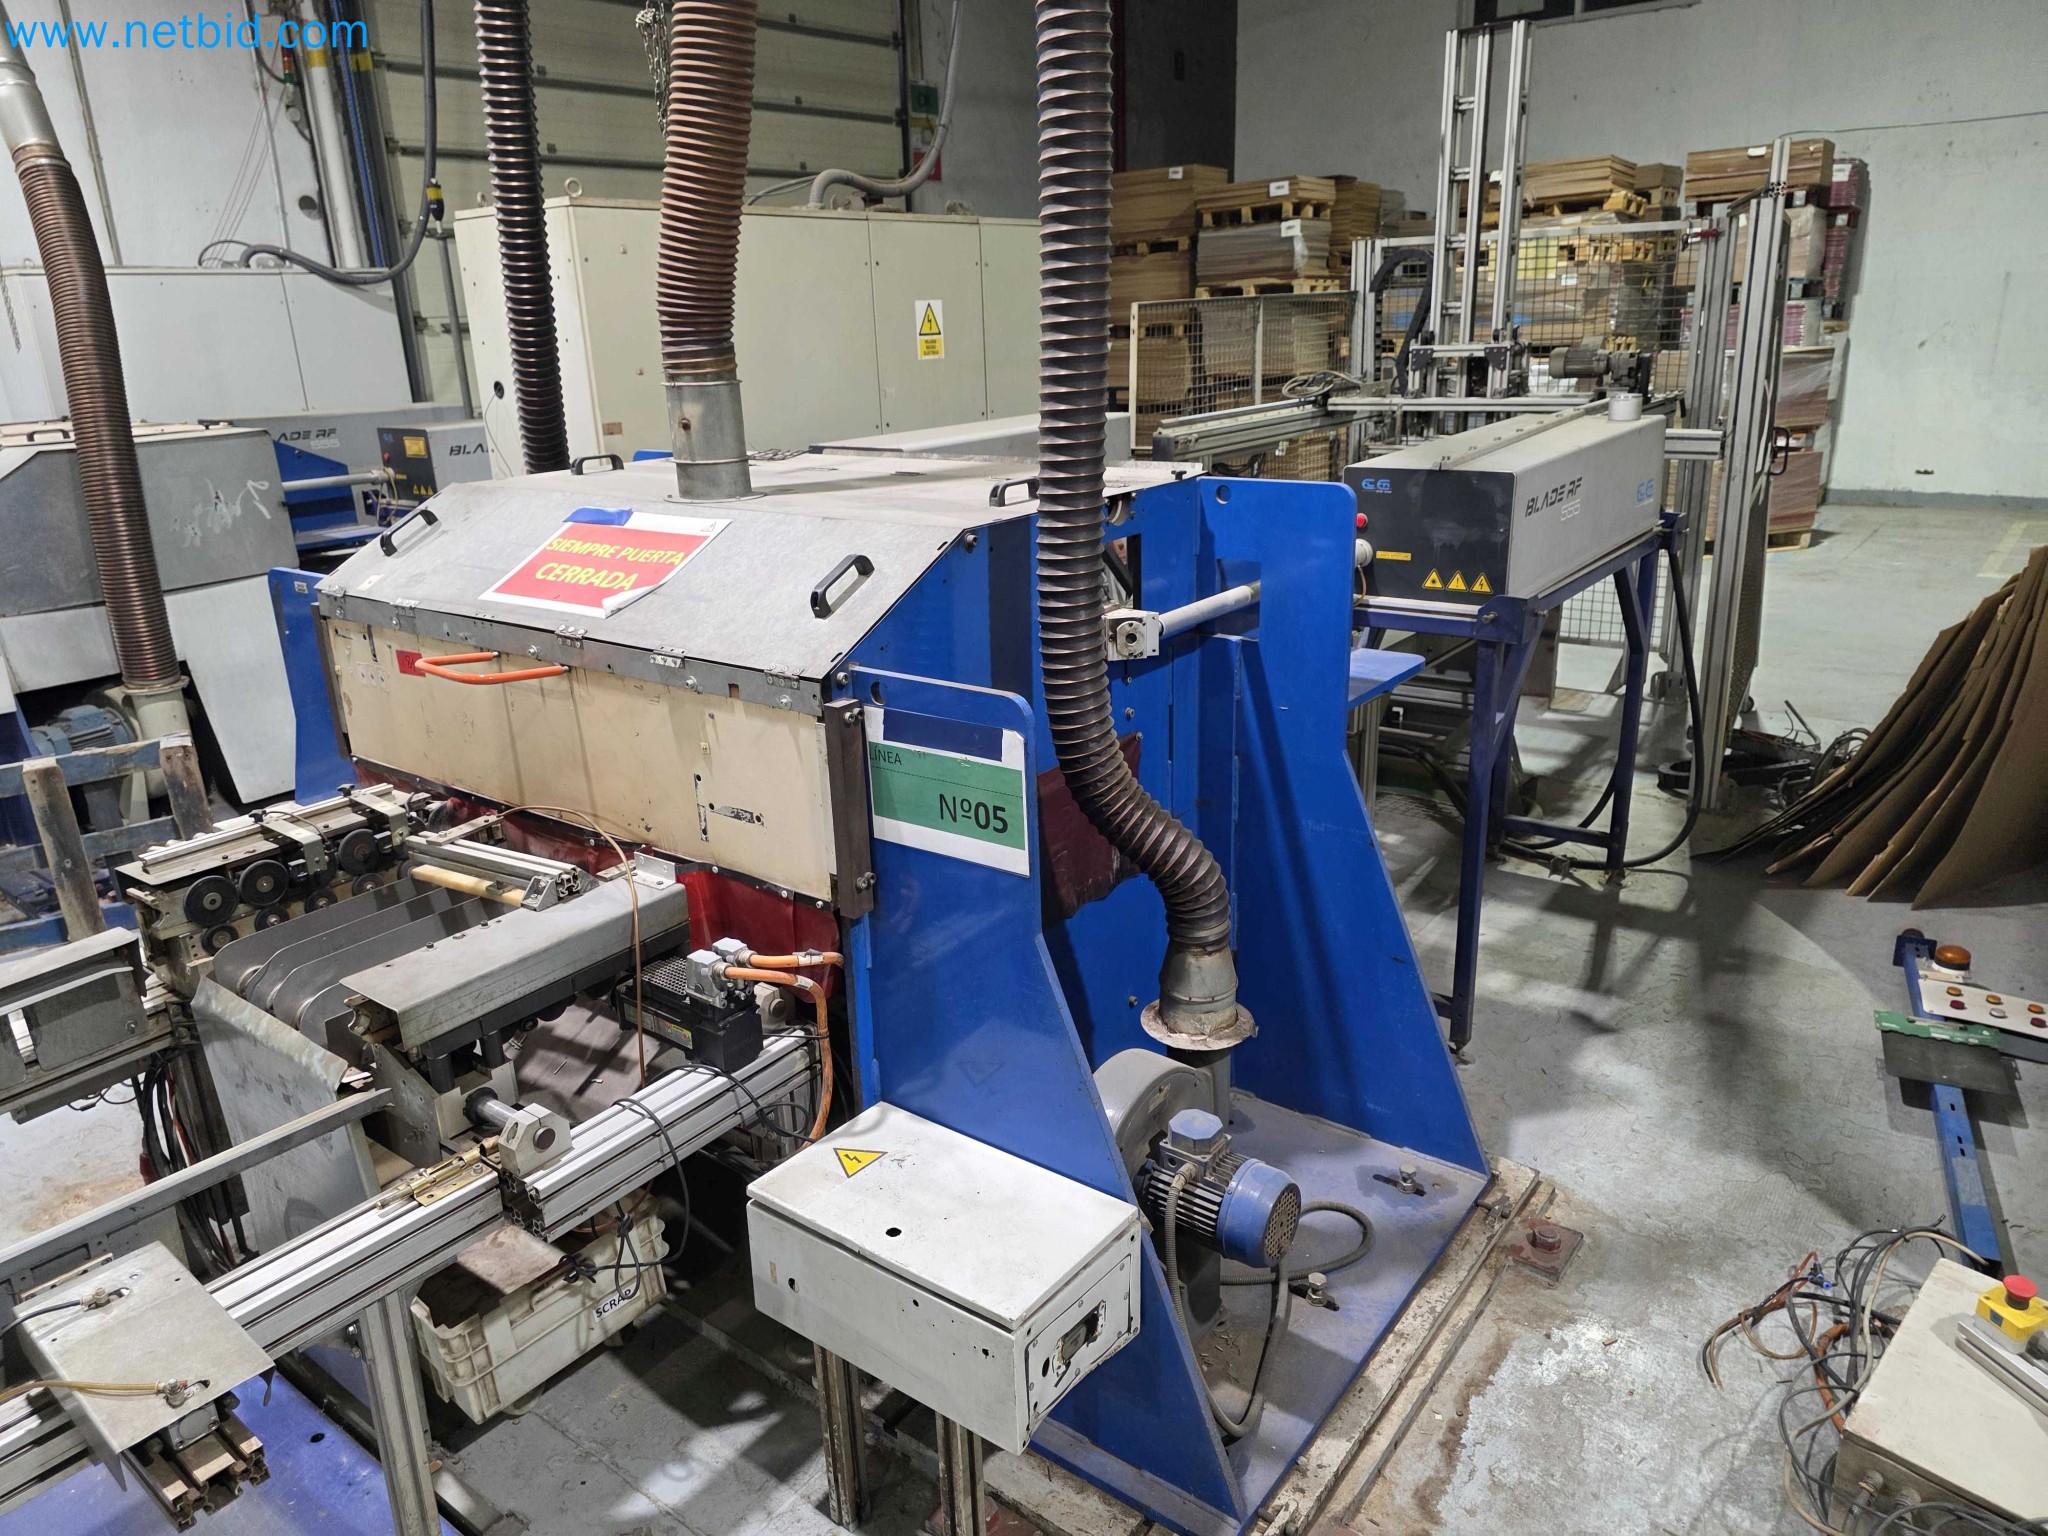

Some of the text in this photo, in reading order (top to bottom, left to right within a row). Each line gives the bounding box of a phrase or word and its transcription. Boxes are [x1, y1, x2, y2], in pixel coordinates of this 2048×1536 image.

[277, 428, 337, 441] ADE RF
[449, 443, 489, 456] BLA
[1525, 476, 1583, 518] BLADE RF
[545, 537, 684, 566] SIEMPRE PUERTA
[535, 562, 639, 591] CERRADA
